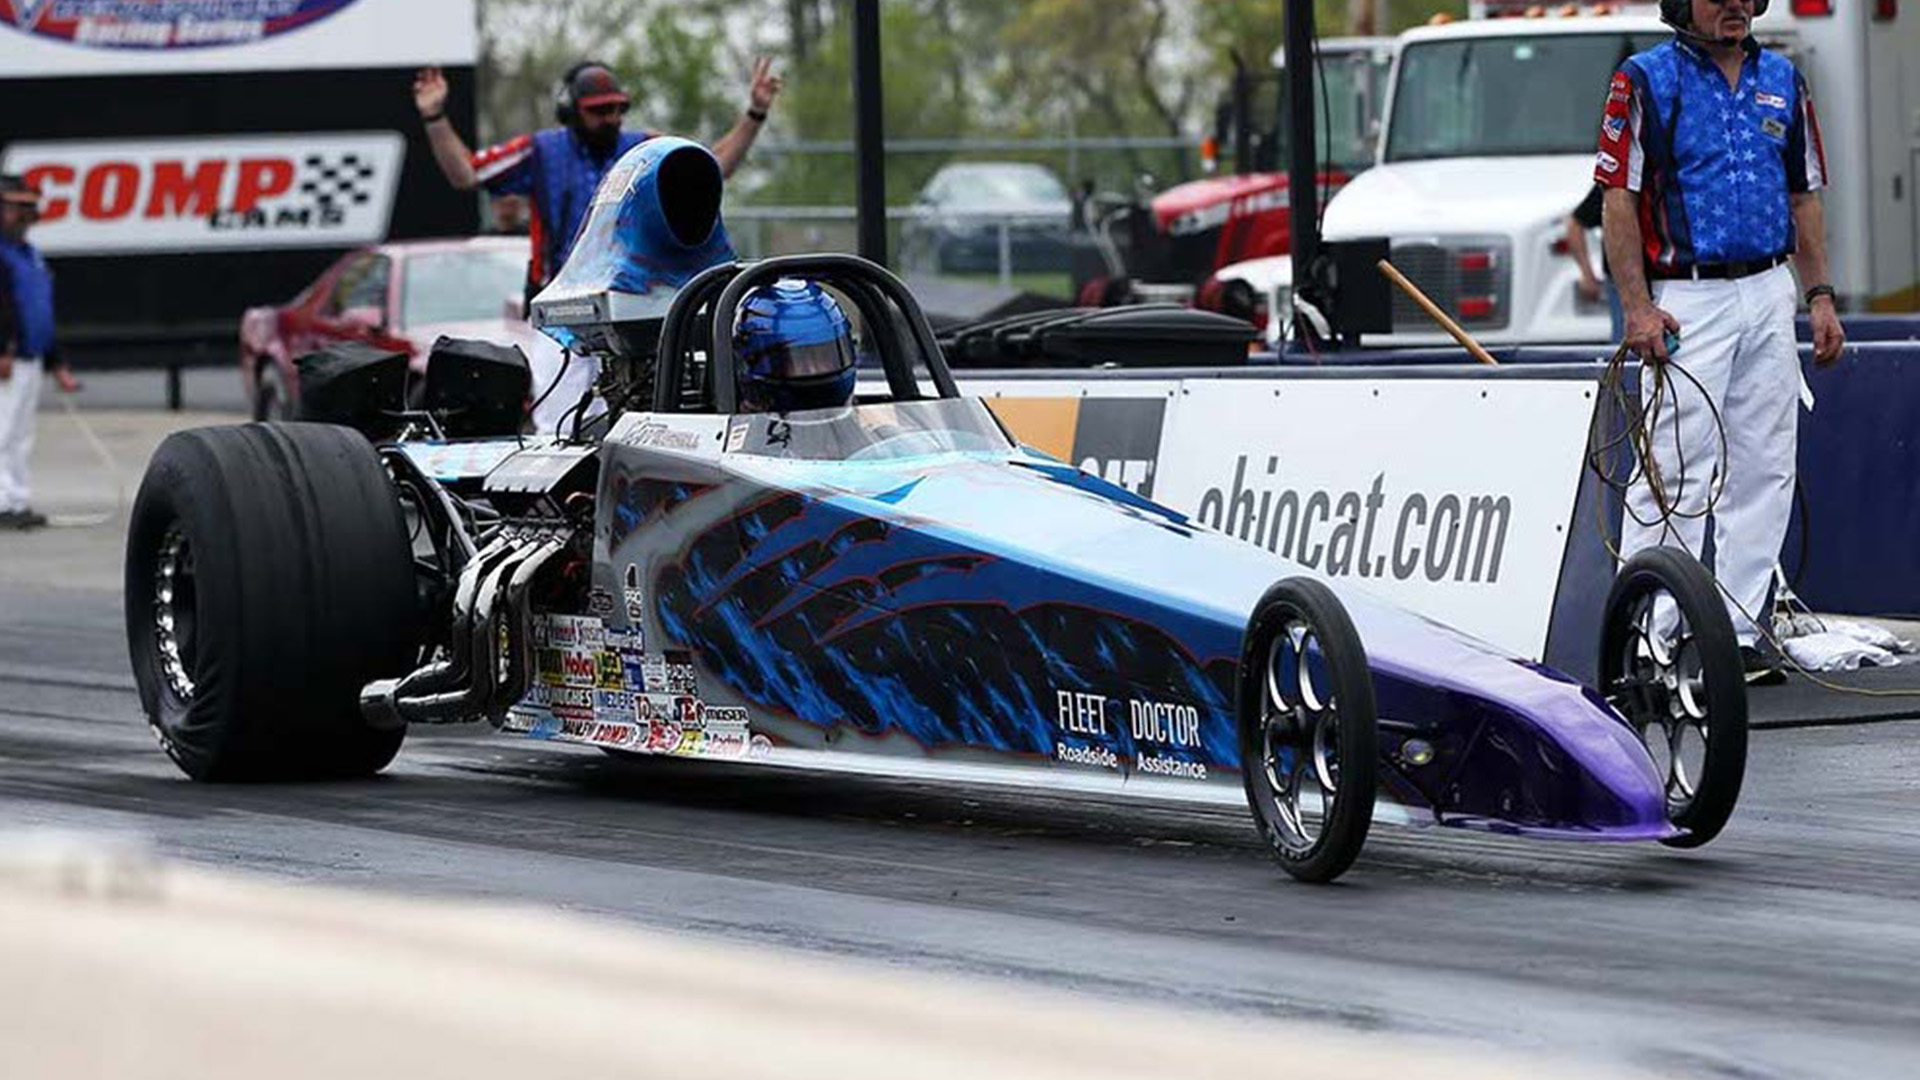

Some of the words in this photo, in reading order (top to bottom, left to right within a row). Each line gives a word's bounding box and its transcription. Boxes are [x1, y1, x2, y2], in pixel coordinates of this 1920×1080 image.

[25, 160, 294, 222] COMP
[209, 205, 345, 230] CAMS
[1056, 690, 1107, 735] FLEET
[1129, 699, 1201, 748] DOCTOR
[1057, 743, 1118, 768] Roadside
[1137, 752, 1207, 779] Assistance
